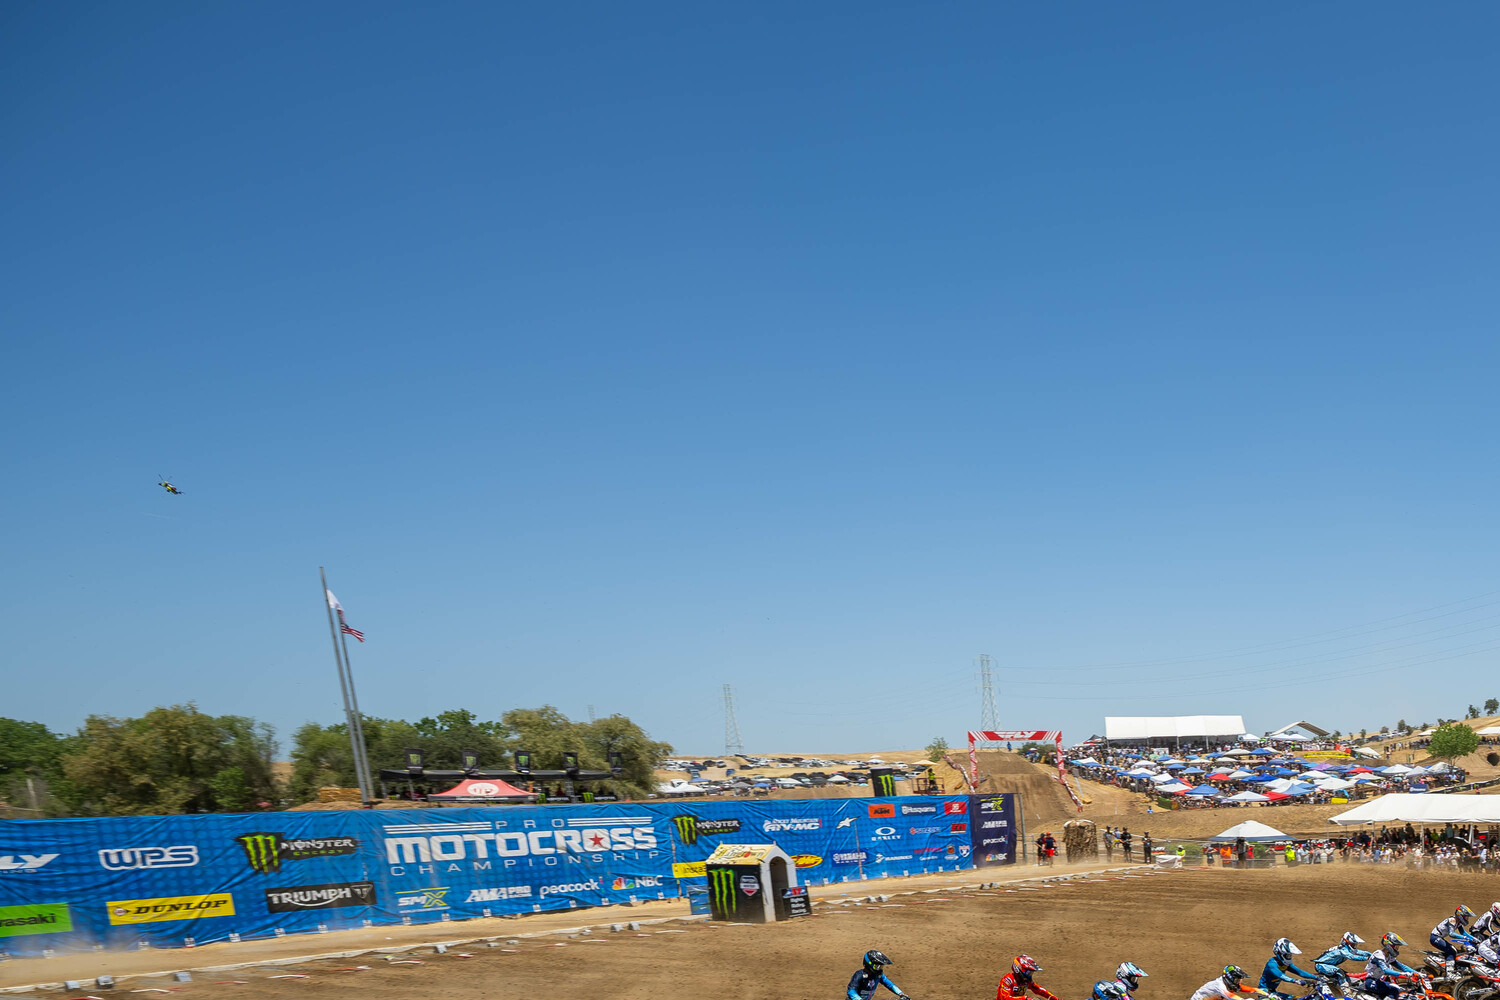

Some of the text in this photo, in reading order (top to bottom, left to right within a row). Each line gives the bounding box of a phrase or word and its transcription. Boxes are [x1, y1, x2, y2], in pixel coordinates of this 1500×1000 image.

[993, 731, 1037, 739] FLY
[495, 818, 565, 830] PRO
[696, 820, 740, 829] MONSTER
[281, 839, 355, 851] MONSTER
[384, 827, 657, 864] MOTOCROSS
[0, 853, 61, 870] LY
[98, 845, 199, 871] WPS
[390, 851, 659, 876] CHAMPIONSHIP
[540, 879, 600, 899] peacock
[635, 875, 663, 888] NBC
[267, 887, 352, 906] TRIUMPH
[398, 891, 448, 907] SMX
[133, 900, 228, 915] DUNLOP
